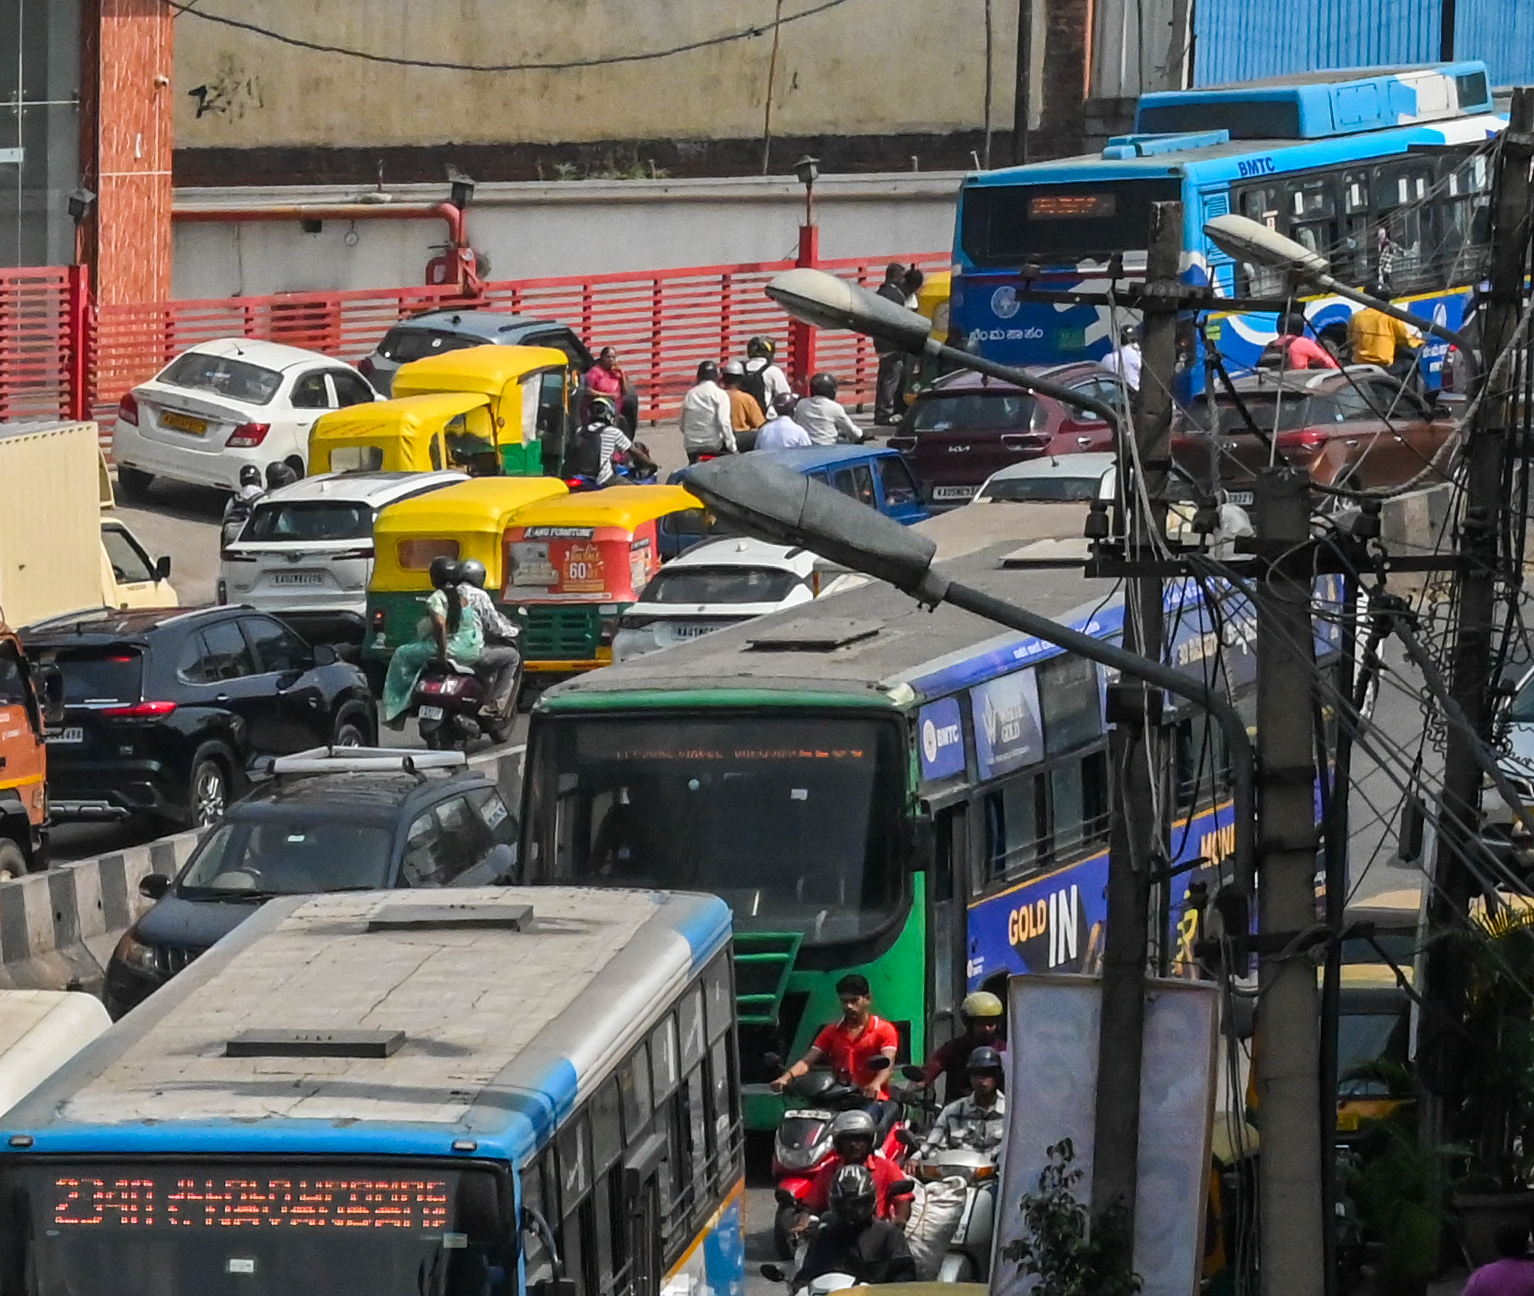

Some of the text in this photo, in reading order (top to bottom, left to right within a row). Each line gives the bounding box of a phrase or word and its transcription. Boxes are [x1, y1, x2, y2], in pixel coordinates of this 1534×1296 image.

[1238, 156, 1276, 178] BMTC
[1007, 884, 1078, 969] GOLD IN
